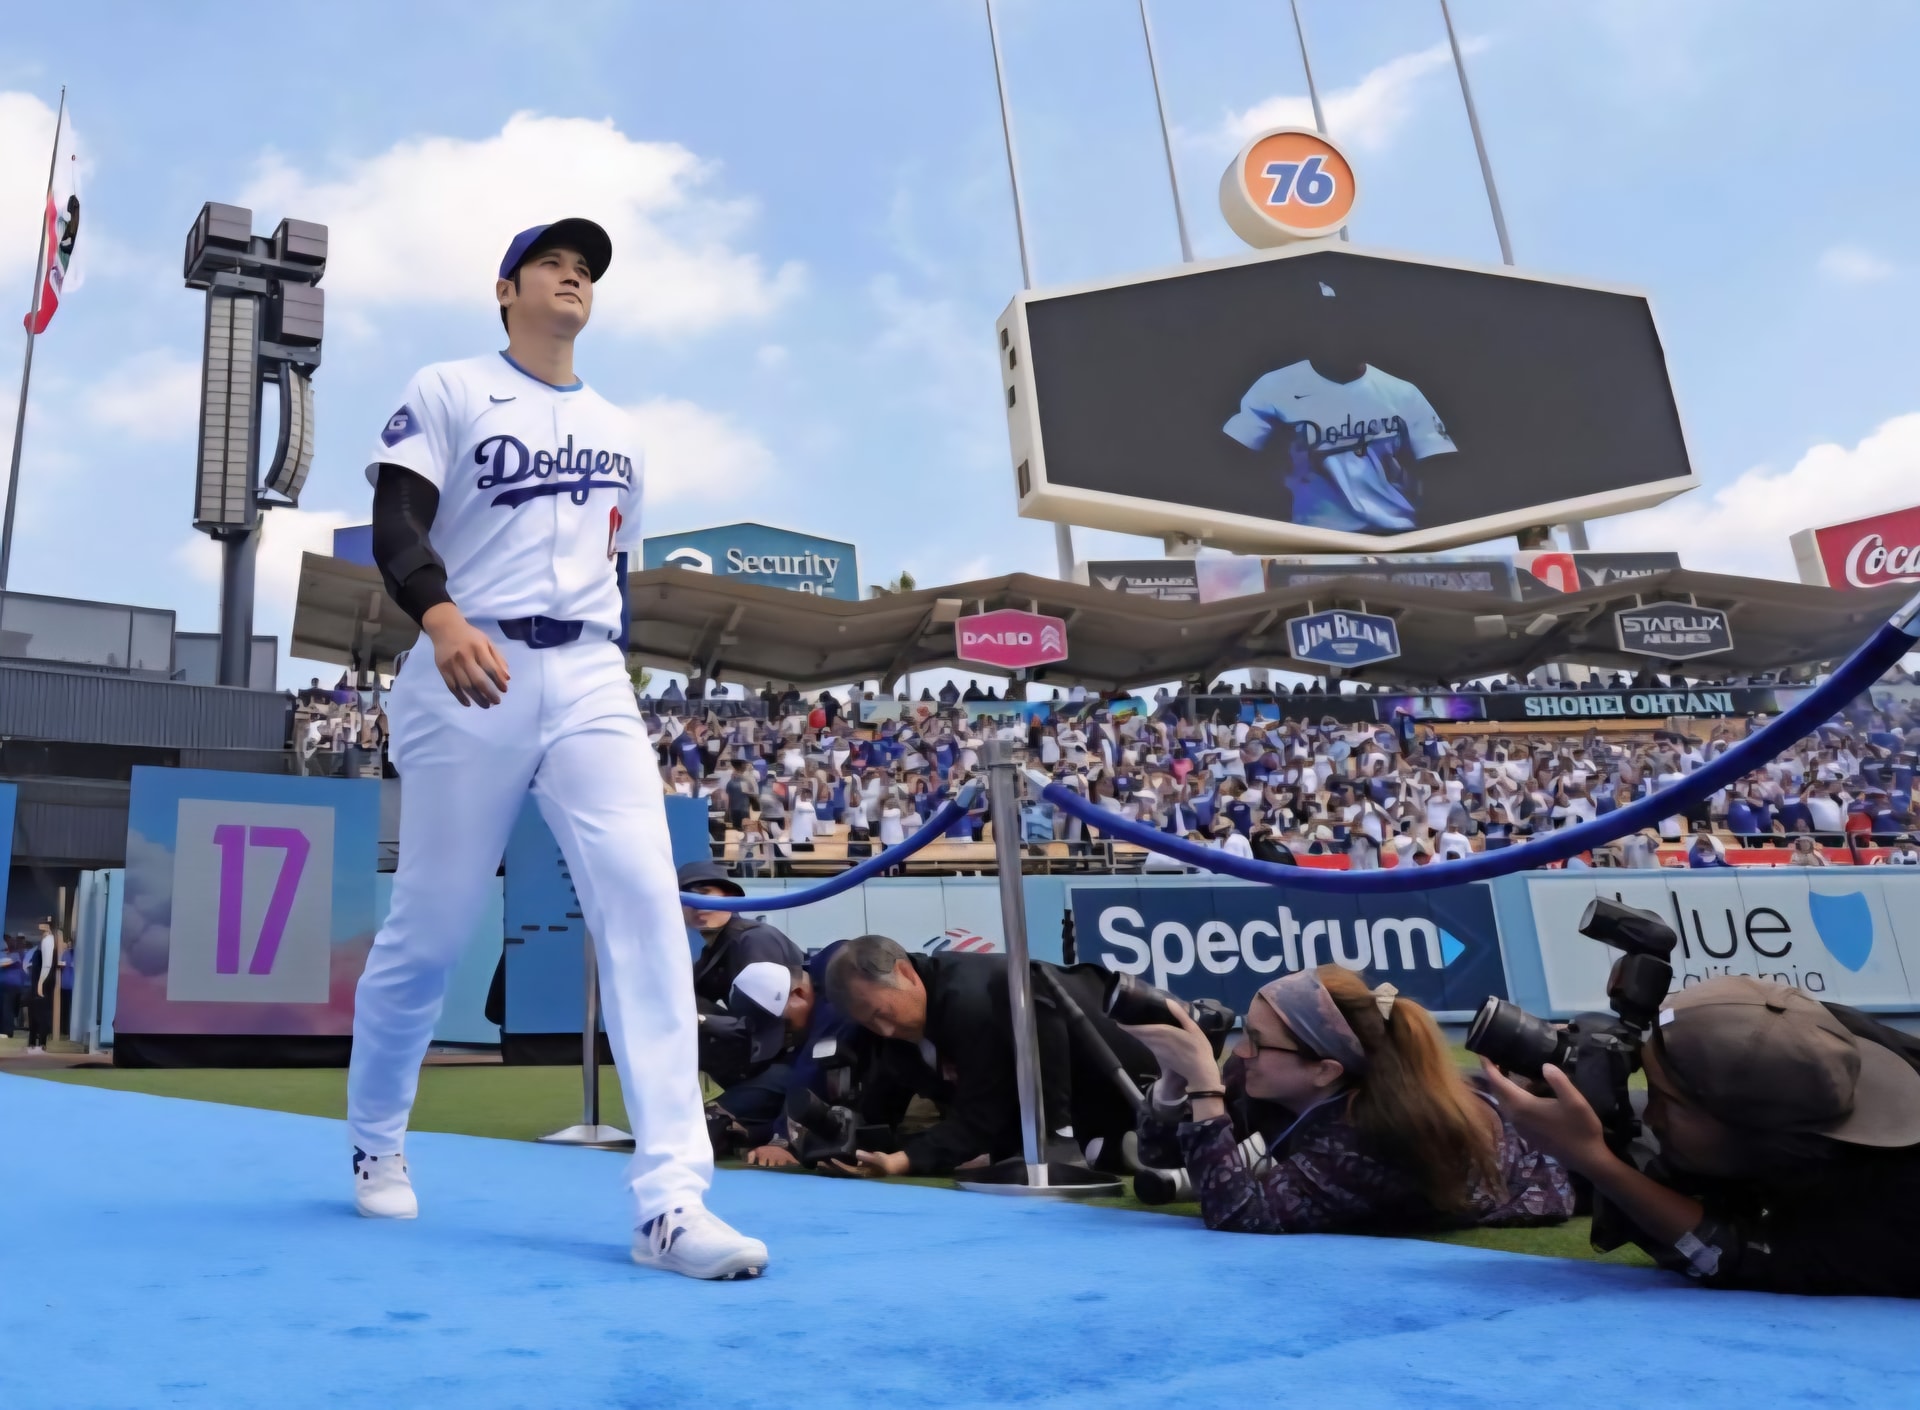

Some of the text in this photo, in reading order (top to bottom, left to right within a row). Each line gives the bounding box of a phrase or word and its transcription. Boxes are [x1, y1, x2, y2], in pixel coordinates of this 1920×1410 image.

[1261, 155, 1336, 207] 76
[727, 548, 840, 582] Security
[1298, 622, 1333, 656] JIM
[1622, 615, 1722, 632] STARLUX
[1525, 692, 1735, 717] SHOHEI OHTANI
[213, 824, 311, 975] 17
[1615, 890, 1792, 959] lue
[1099, 905, 1443, 991] Spectrum
